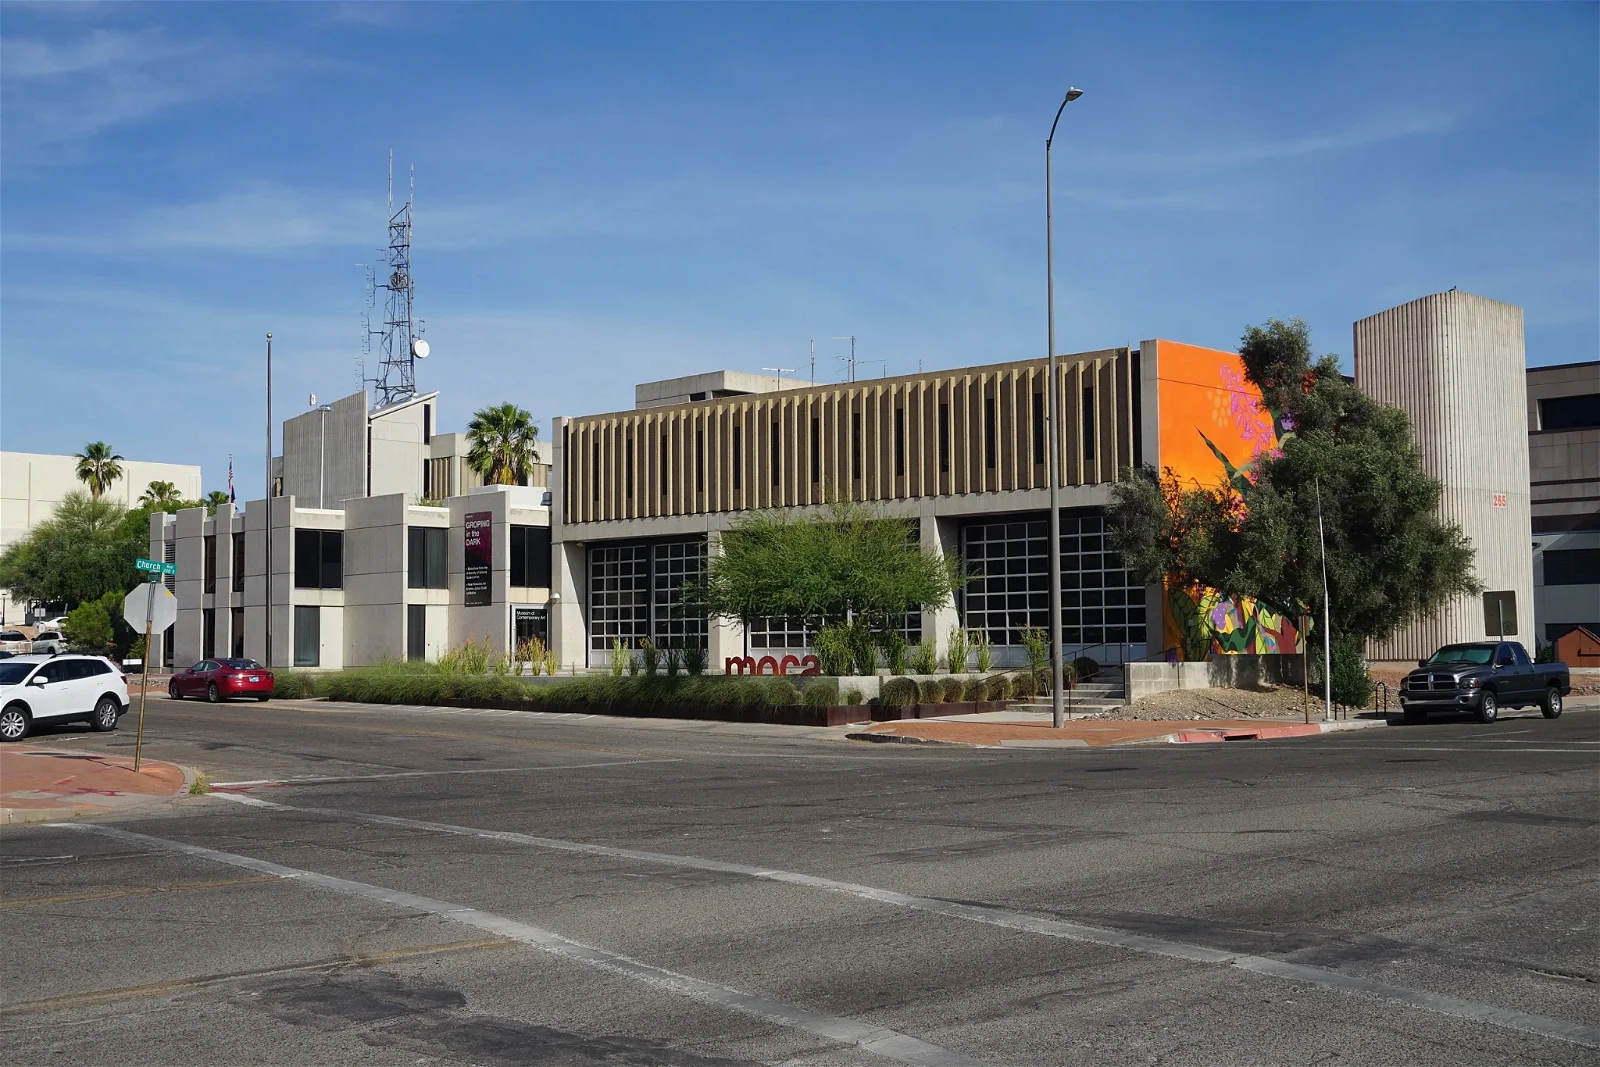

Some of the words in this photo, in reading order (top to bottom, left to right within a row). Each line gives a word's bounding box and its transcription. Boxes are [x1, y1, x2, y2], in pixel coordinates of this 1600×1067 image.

[1493, 494, 1507, 508] 265
[466, 520, 490, 529] GROPING
[466, 538, 481, 546] DARK
[137, 561, 161, 570] Church
[725, 654, 821, 676] moca
